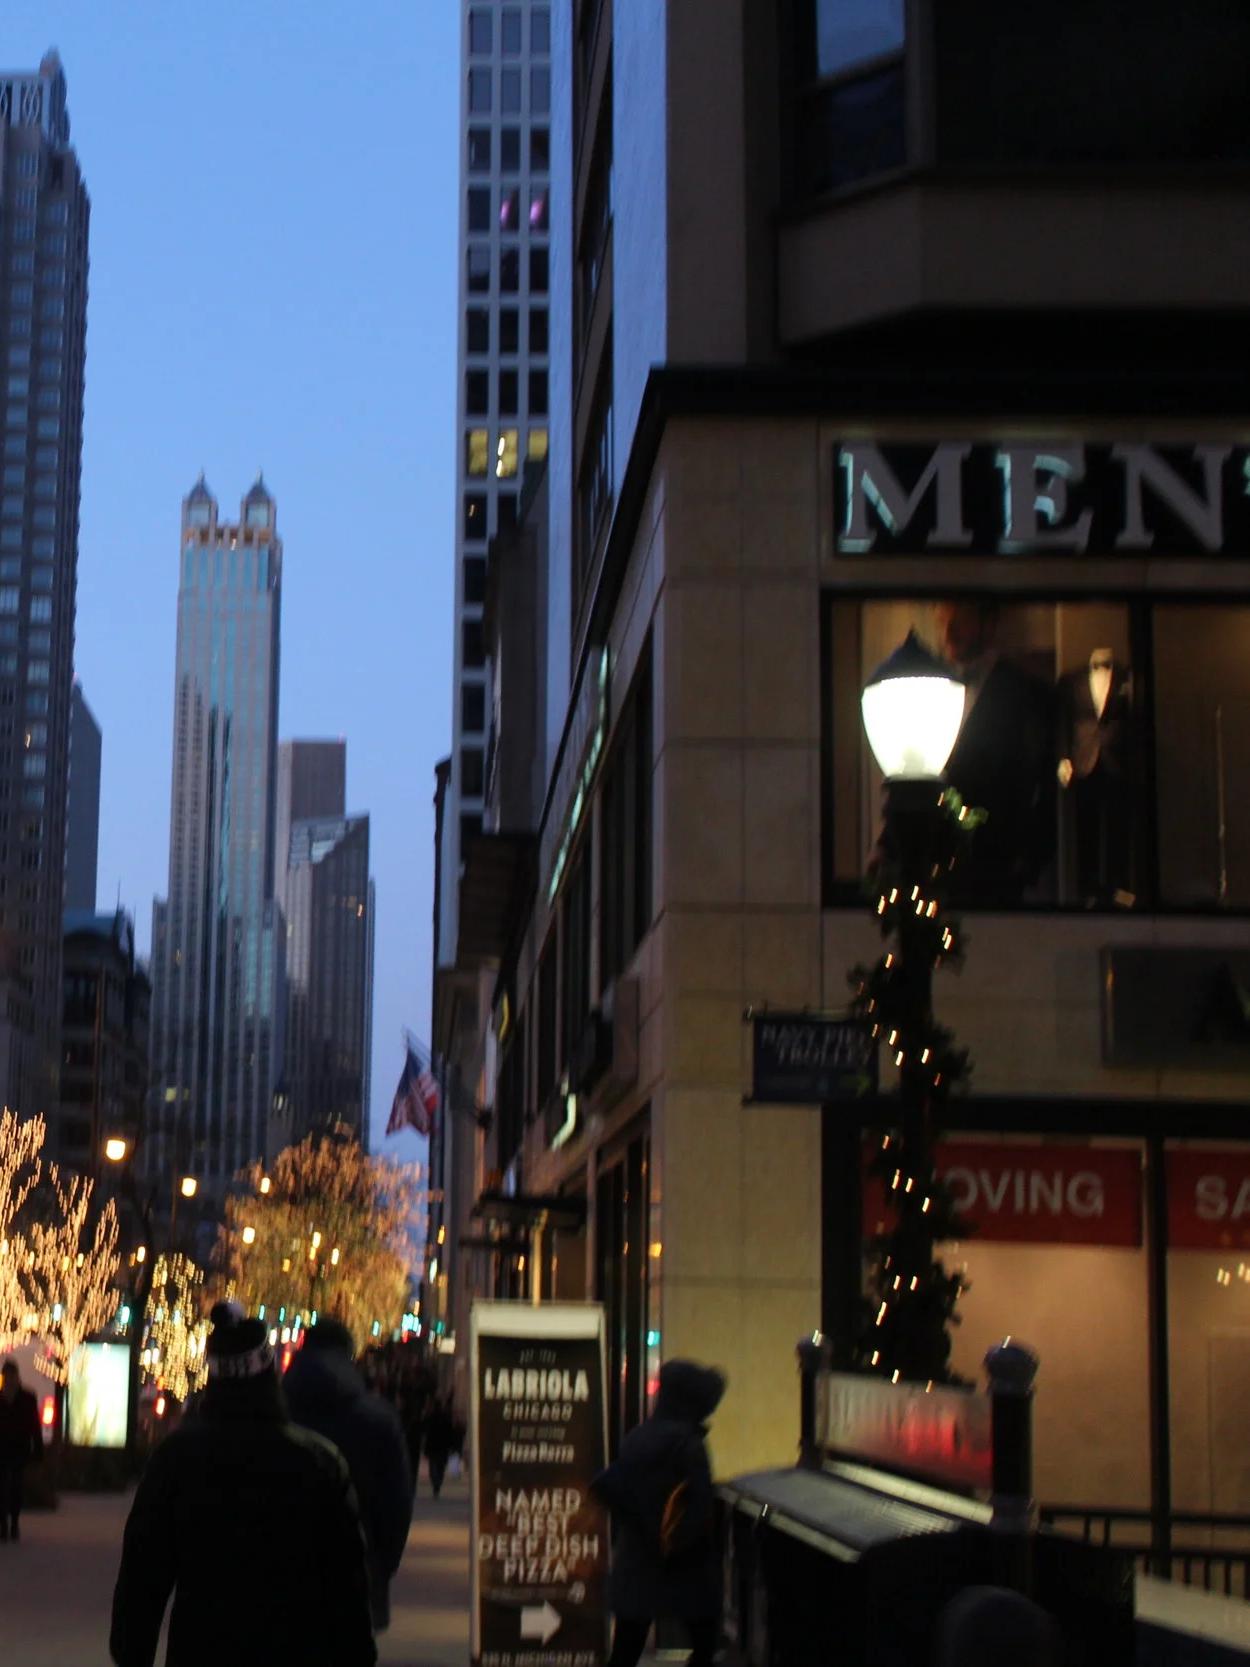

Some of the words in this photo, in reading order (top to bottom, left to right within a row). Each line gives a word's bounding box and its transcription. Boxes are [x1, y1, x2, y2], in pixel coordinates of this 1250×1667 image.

[761, 1023, 818, 1049] NAVY
[932, 1166, 1105, 1218] OVING
[484, 1367, 590, 1401] LABRIOLA
[503, 1402, 573, 1422] CHICAGO
[495, 1487, 582, 1516] NAMED
[479, 1533, 539, 1562] DEEP
[546, 1533, 599, 1561] DISH
